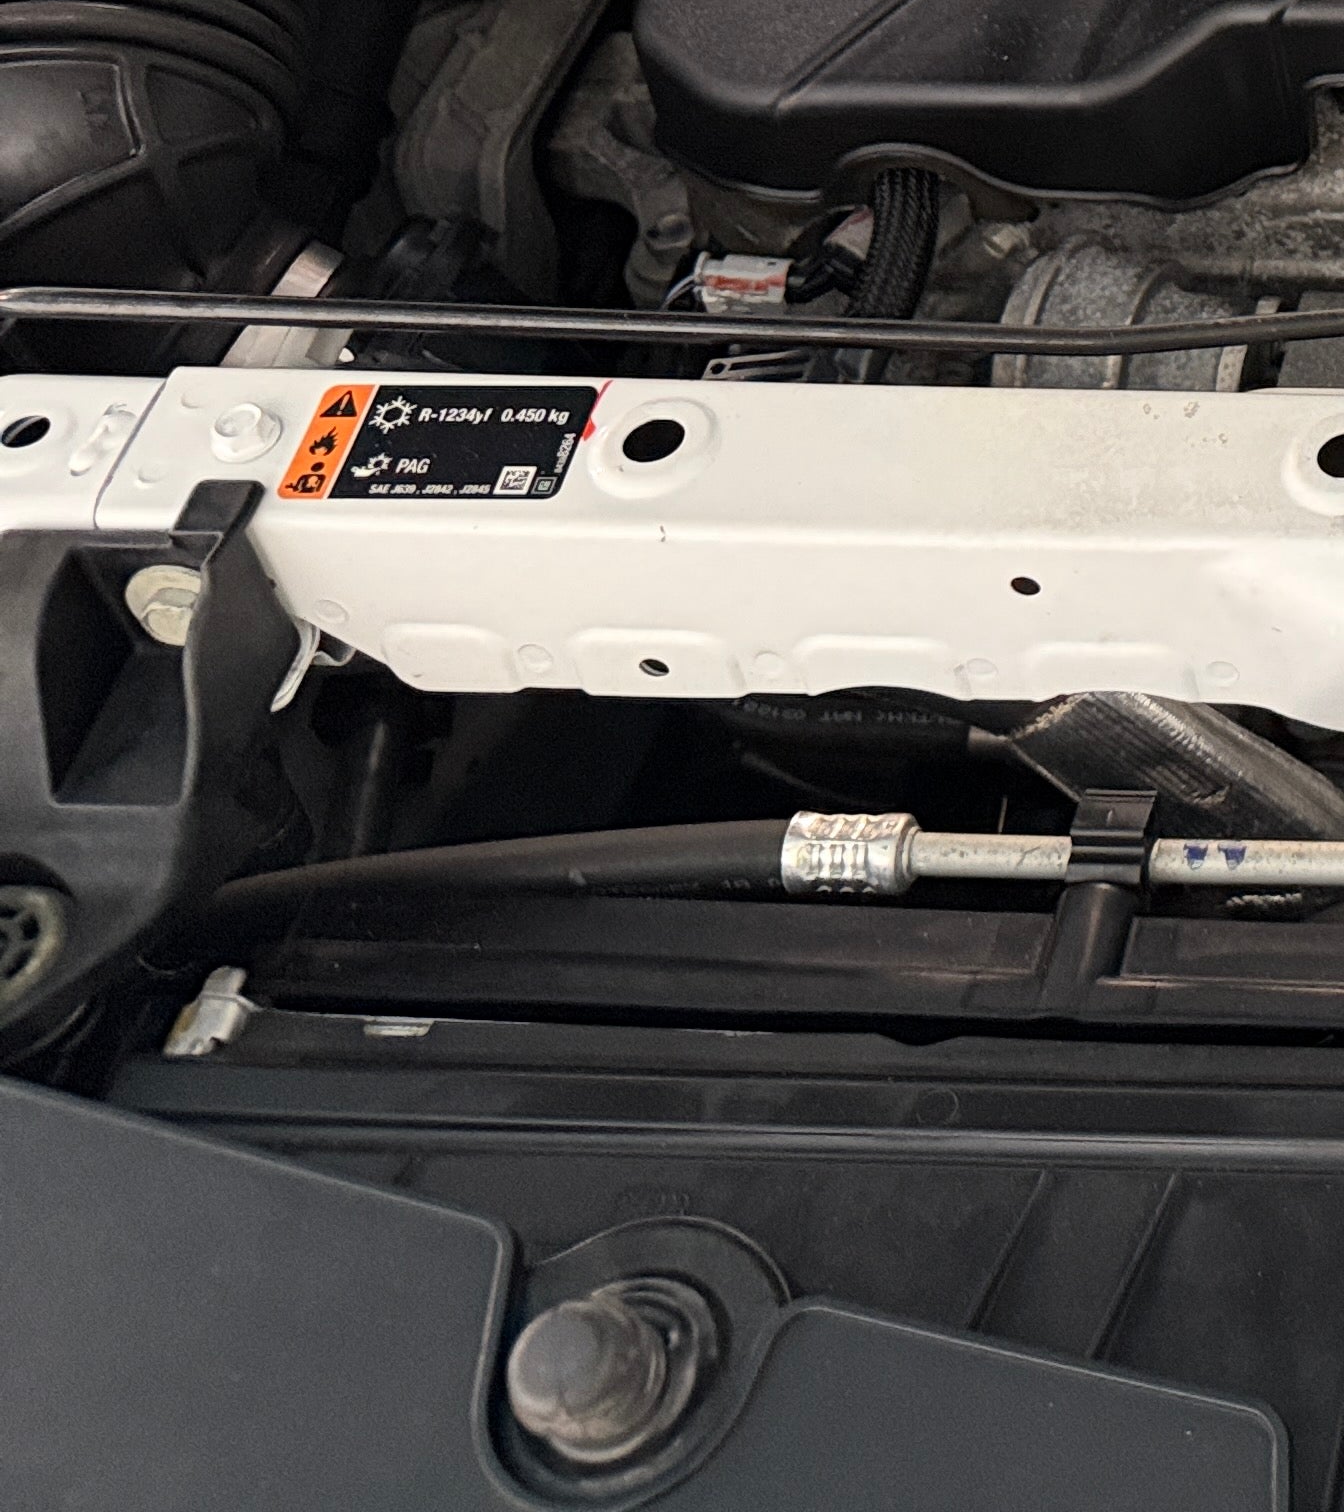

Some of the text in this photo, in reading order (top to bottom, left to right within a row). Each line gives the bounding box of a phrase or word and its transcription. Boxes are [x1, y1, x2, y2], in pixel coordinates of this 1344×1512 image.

[418, 407, 570, 425] R-1234yf 0.450 kg
[395, 458, 431, 474] PAG
[368, 484, 390, 494] SAE
